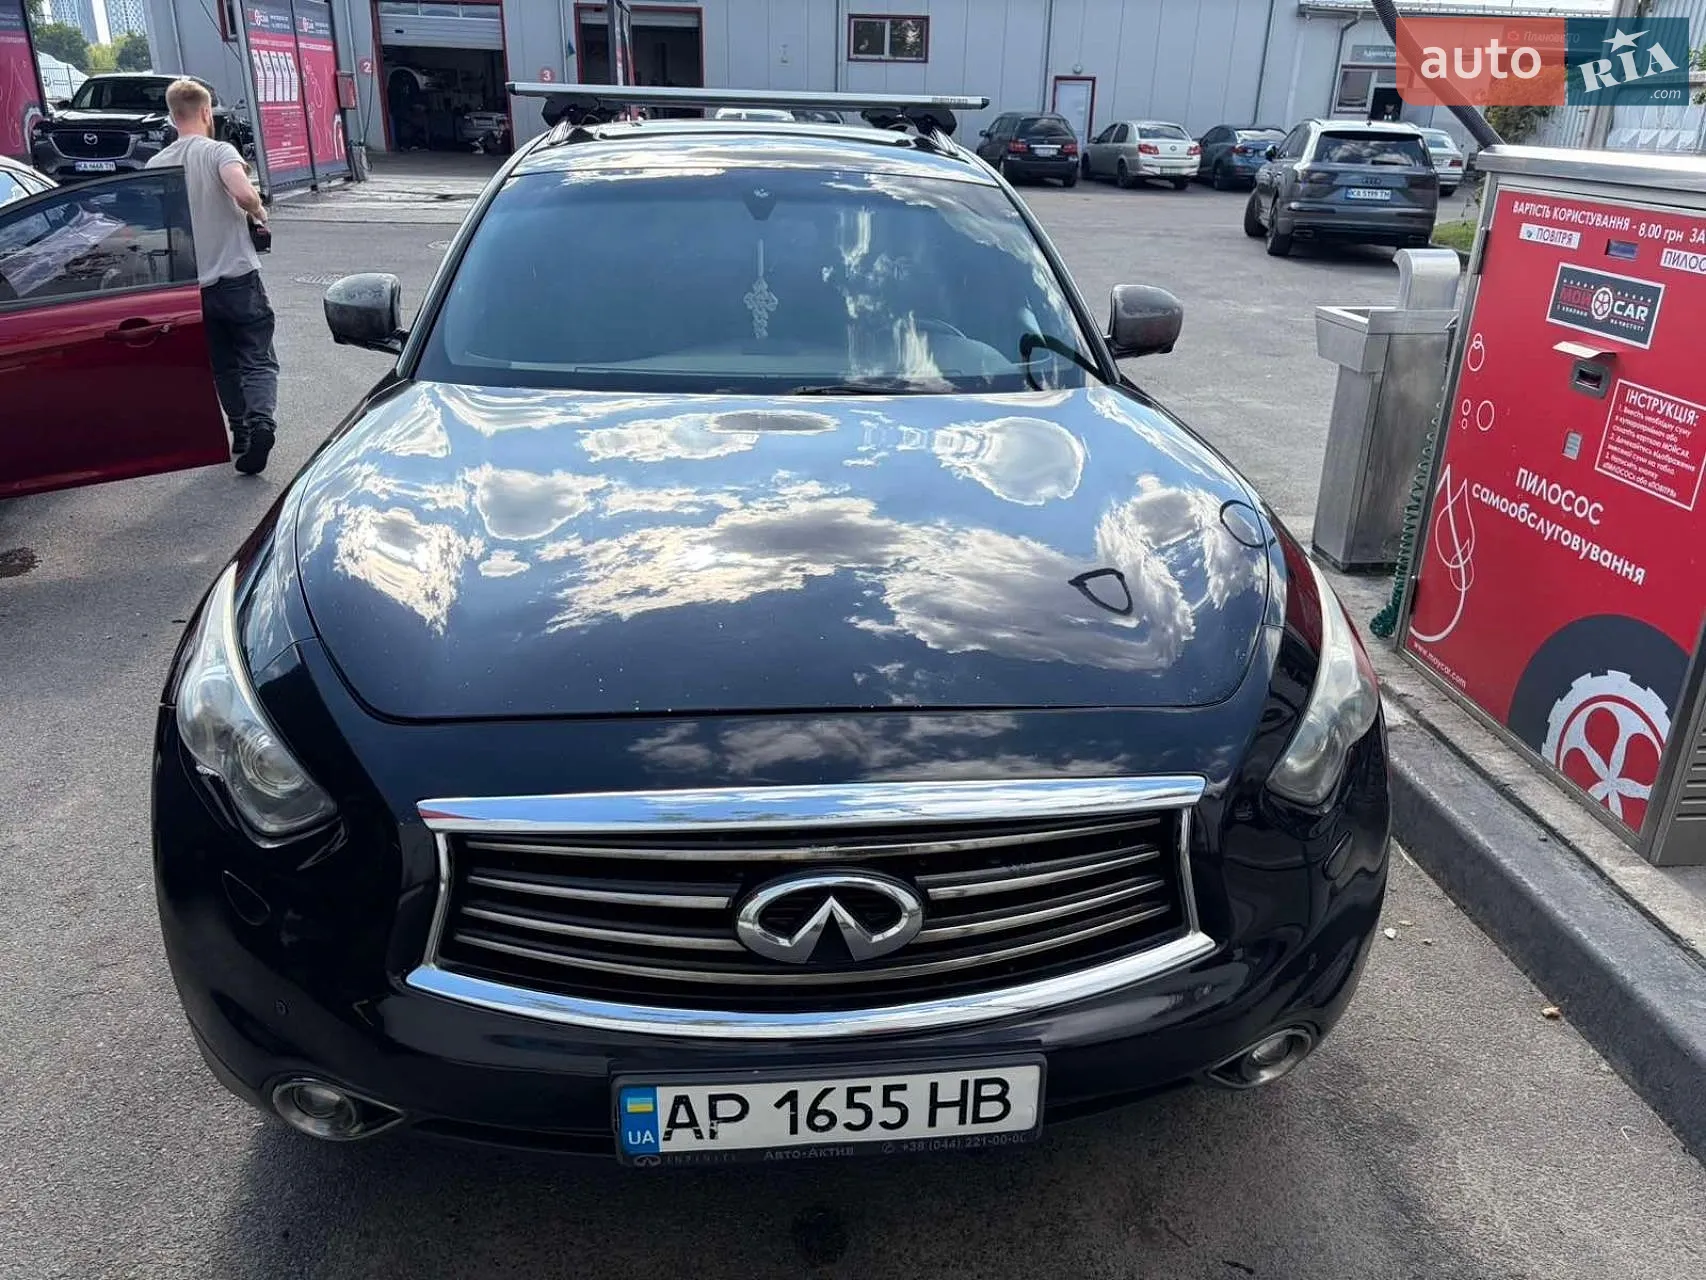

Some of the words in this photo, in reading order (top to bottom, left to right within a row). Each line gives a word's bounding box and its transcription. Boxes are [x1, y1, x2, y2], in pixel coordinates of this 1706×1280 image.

[363, 61, 373, 73] 2
[543, 70, 552, 82] 3
[1513, 201, 1551, 218] ВАРТІСТЬ
[1552, 207, 1630, 231] КОРИСТУВАННЯ
[1638, 223, 1662, 239] 8,00
[1663, 228, 1684, 244] грн
[1536, 228, 1574, 245] ПОВІТРЯ
[1613, 300, 1649, 321] CAR
[1625, 389, 1699, 427] ІНСТРУКЦІЯ:
[1516, 467, 1604, 525] ПИЛОСОС
[1472, 483, 1646, 585] самообслуговування
[662, 1092, 750, 1142] AP
[773, 1082, 909, 1133] 1655
[927, 1076, 1011, 1128] HB
[628, 1130, 655, 1145] UA
